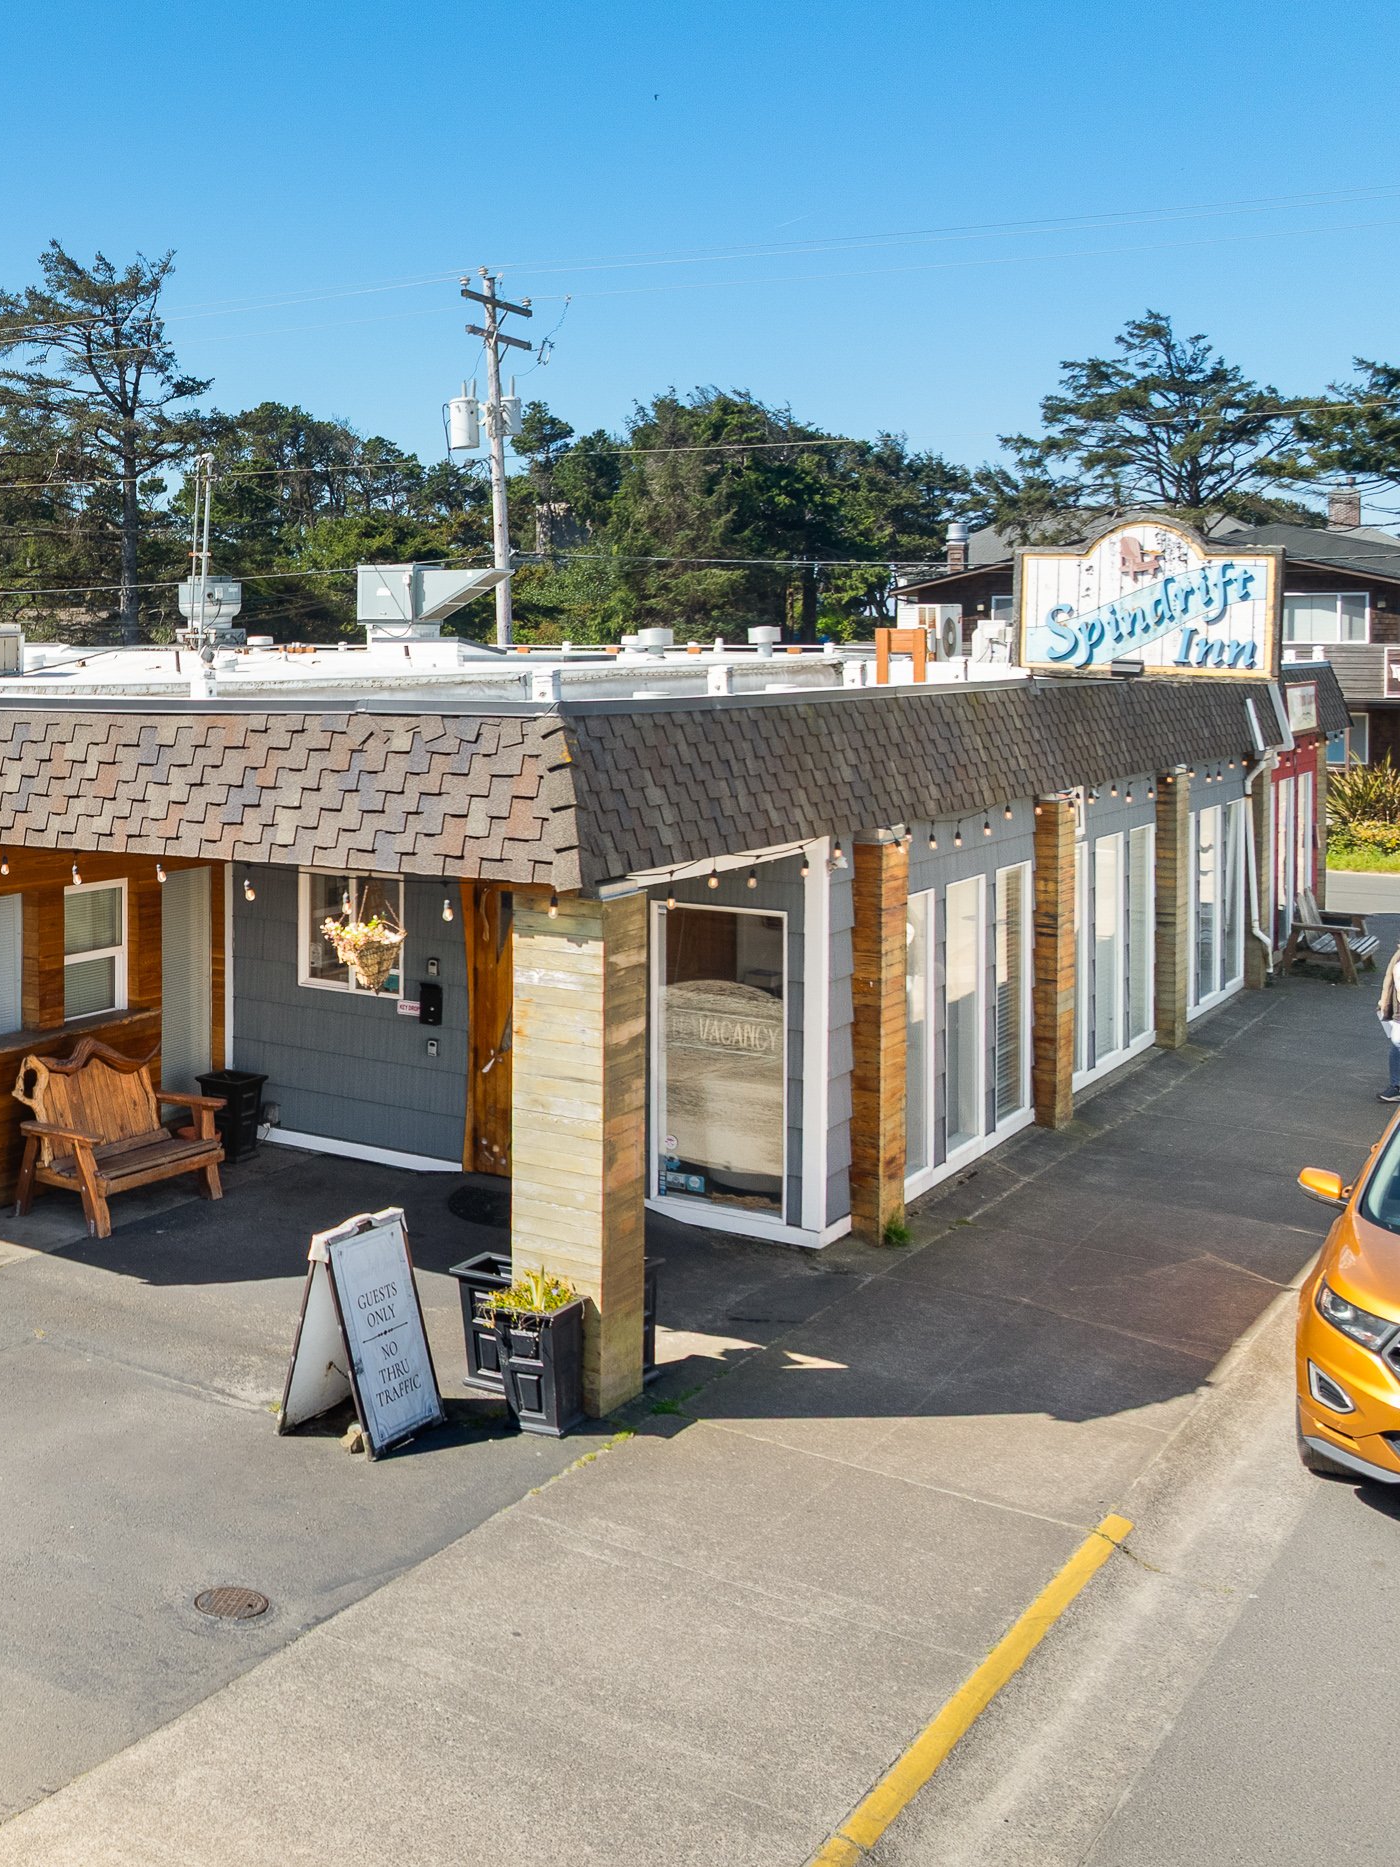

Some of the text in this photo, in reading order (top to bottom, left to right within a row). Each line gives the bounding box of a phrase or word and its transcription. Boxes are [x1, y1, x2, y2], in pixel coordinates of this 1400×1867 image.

[1046, 561, 1255, 668] Spindrift
[1173, 626, 1257, 670] Inn
[699, 1017, 780, 1051] VACANCY
[357, 1281, 398, 1310] GUESTS
[366, 1303, 396, 1328] ONLY
[380, 1340, 398, 1361] NO
[378, 1358, 411, 1385] THRU
[375, 1373, 422, 1408] TRAFFIC
